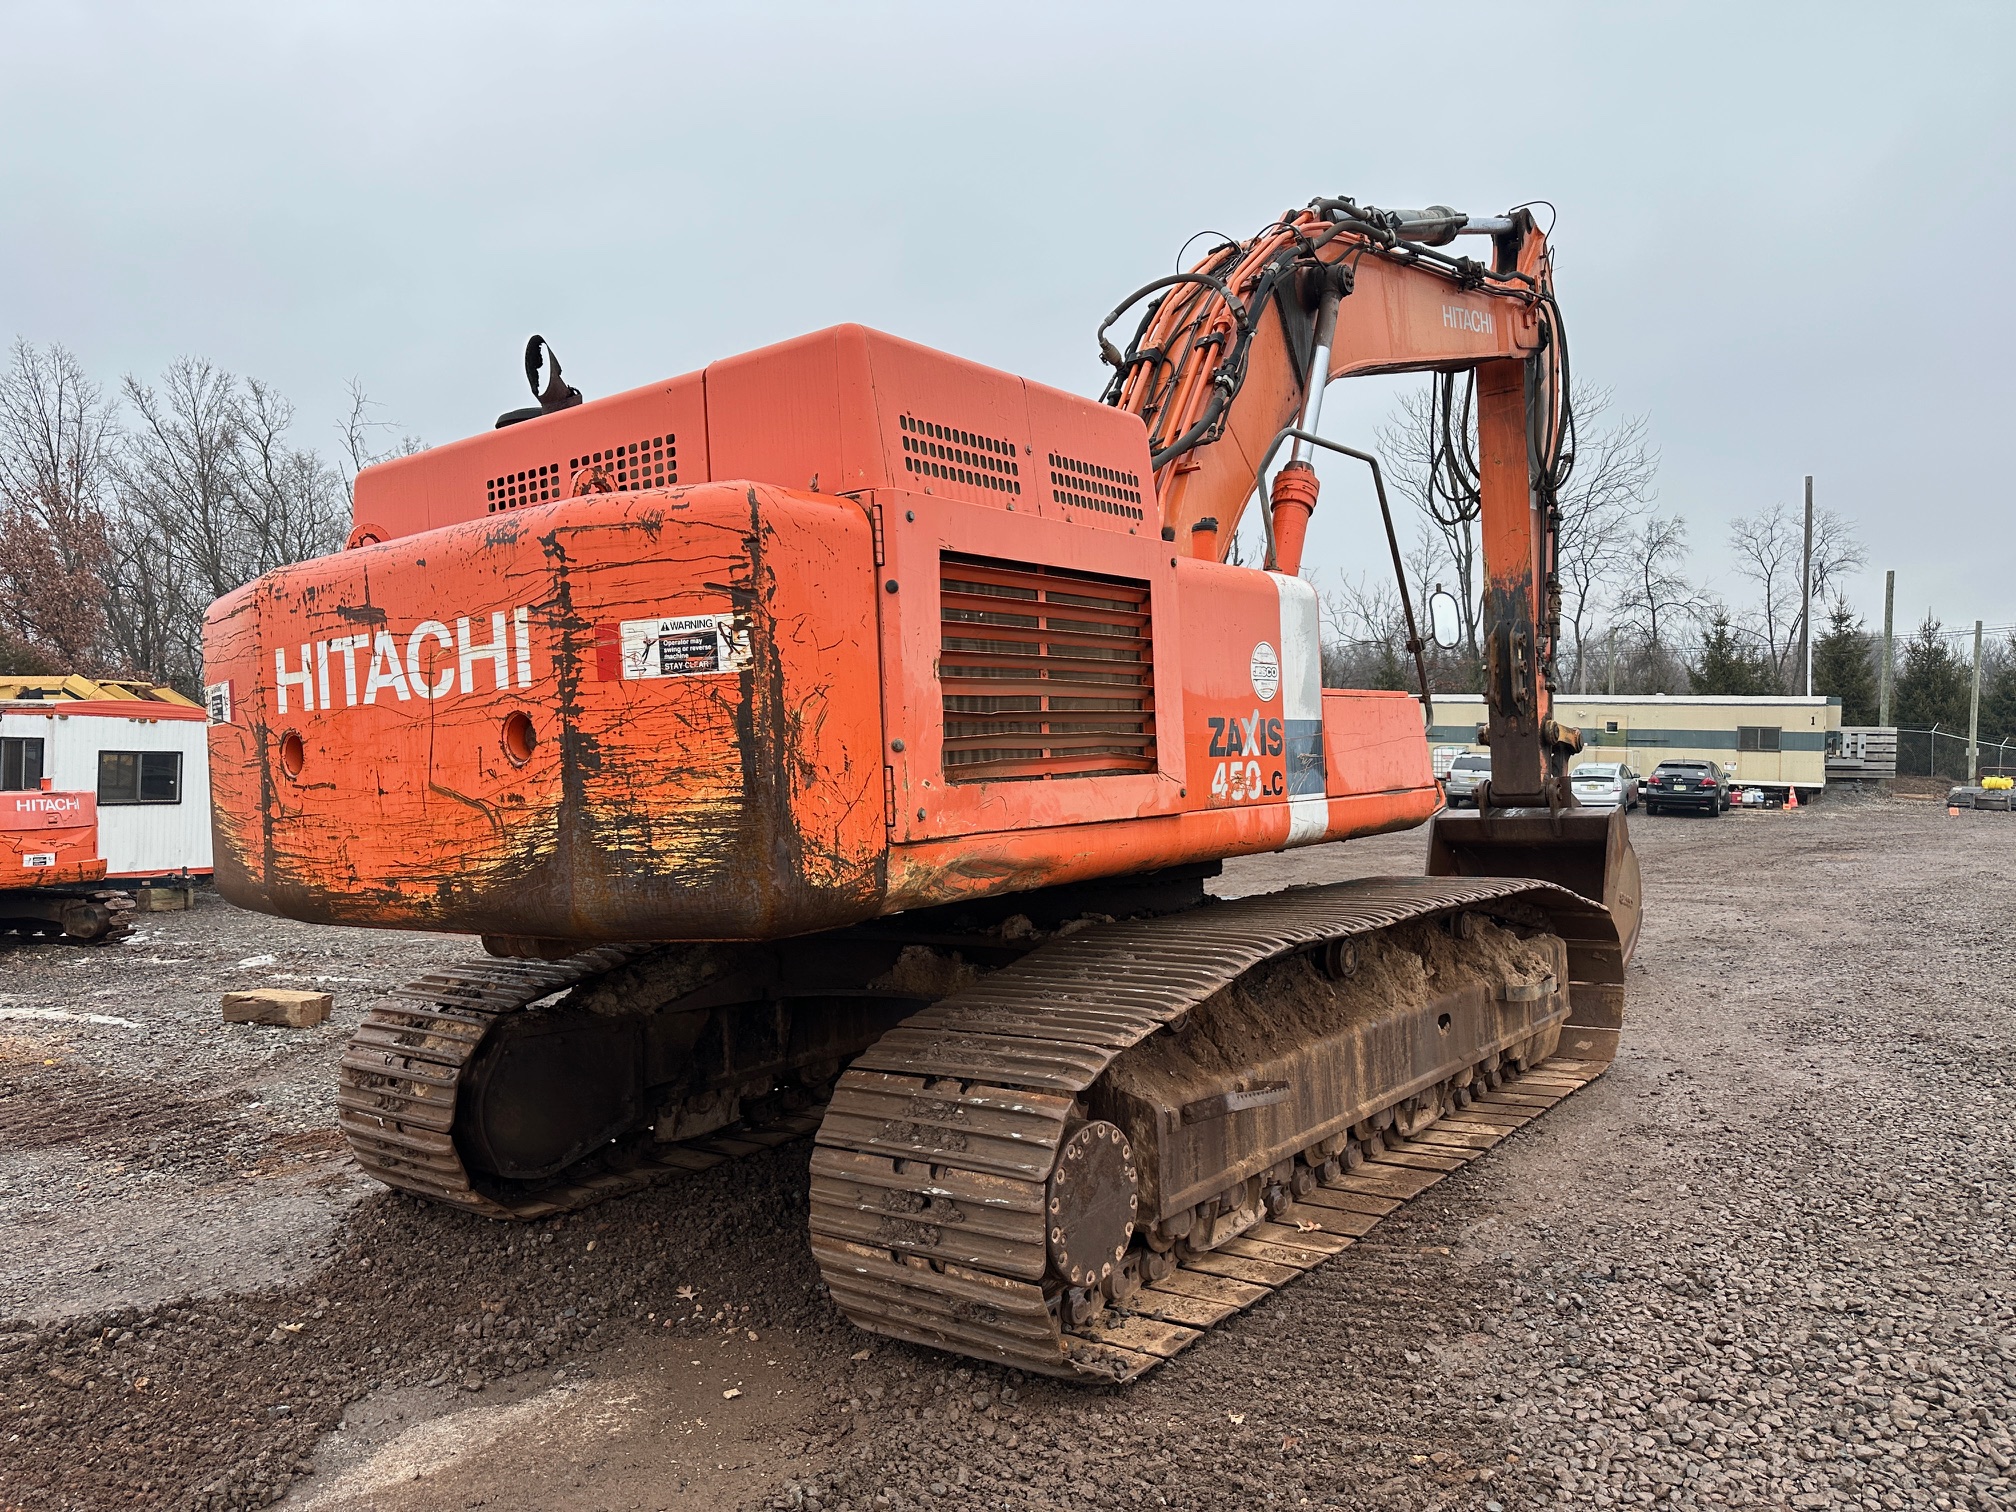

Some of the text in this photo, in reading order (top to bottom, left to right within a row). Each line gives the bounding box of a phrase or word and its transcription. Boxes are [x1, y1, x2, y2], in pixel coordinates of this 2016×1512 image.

[1442, 305, 1493, 334] HITACHI
[670, 619, 713, 630] WARNING
[663, 639, 689, 647] Operator
[275, 606, 532, 715] HITACHI
[664, 661, 684, 670] STAY
[1252, 665, 1277, 678] JESCO
[1208, 708, 1283, 757] ZAXIS
[16, 798, 79, 812] HITACHI
